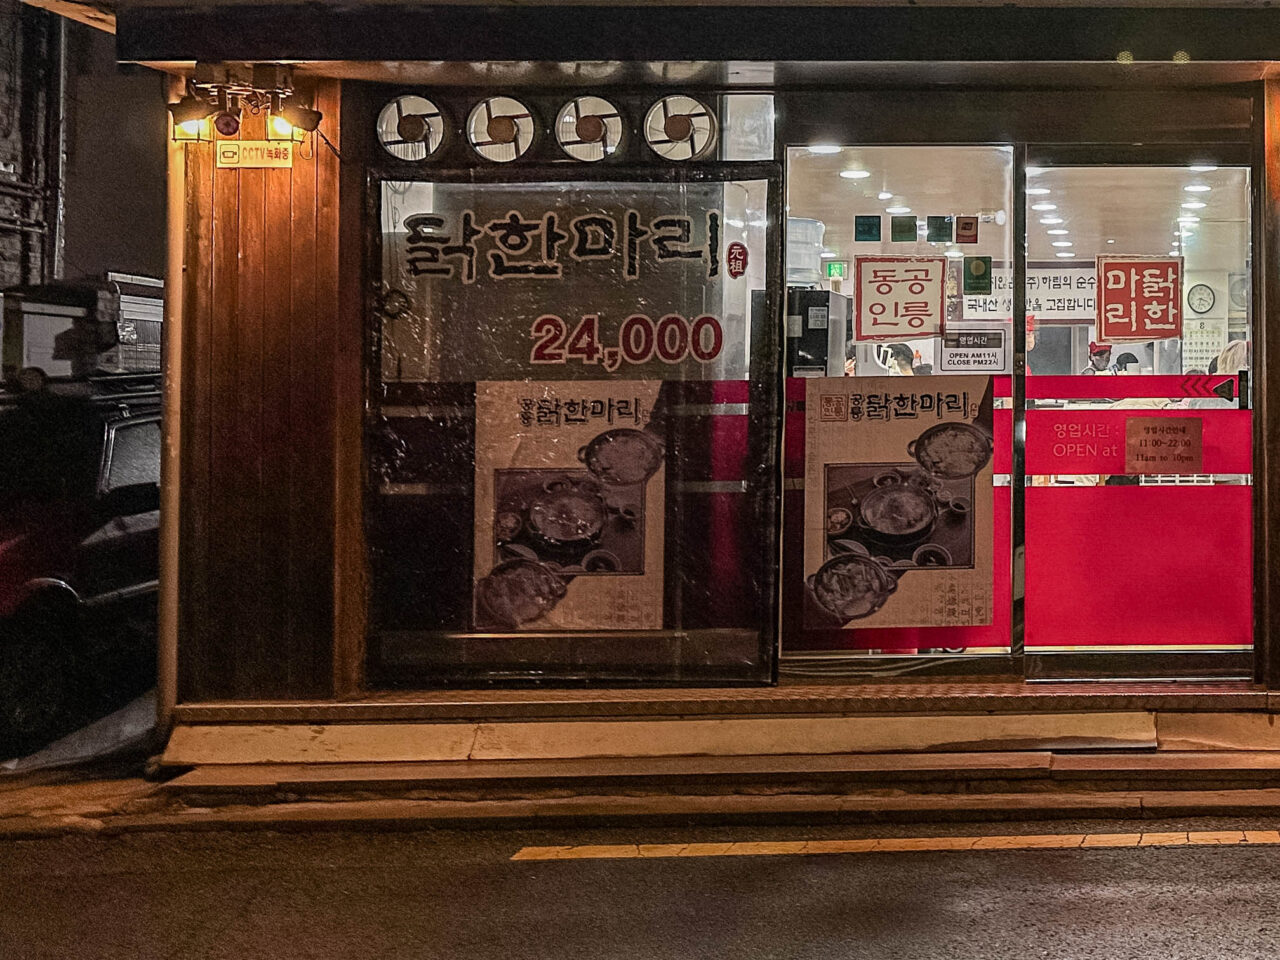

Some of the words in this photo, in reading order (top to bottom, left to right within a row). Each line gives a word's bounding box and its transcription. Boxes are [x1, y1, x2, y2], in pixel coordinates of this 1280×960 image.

[403, 209, 722, 283] 닭한마리
[530, 313, 724, 372] 24,000
[865, 392, 968, 421] 닭한마리
[1053, 423, 1110, 439] 영업시간
[1053, 443, 1097, 457] OPEN
[1102, 443, 1117, 457] at
